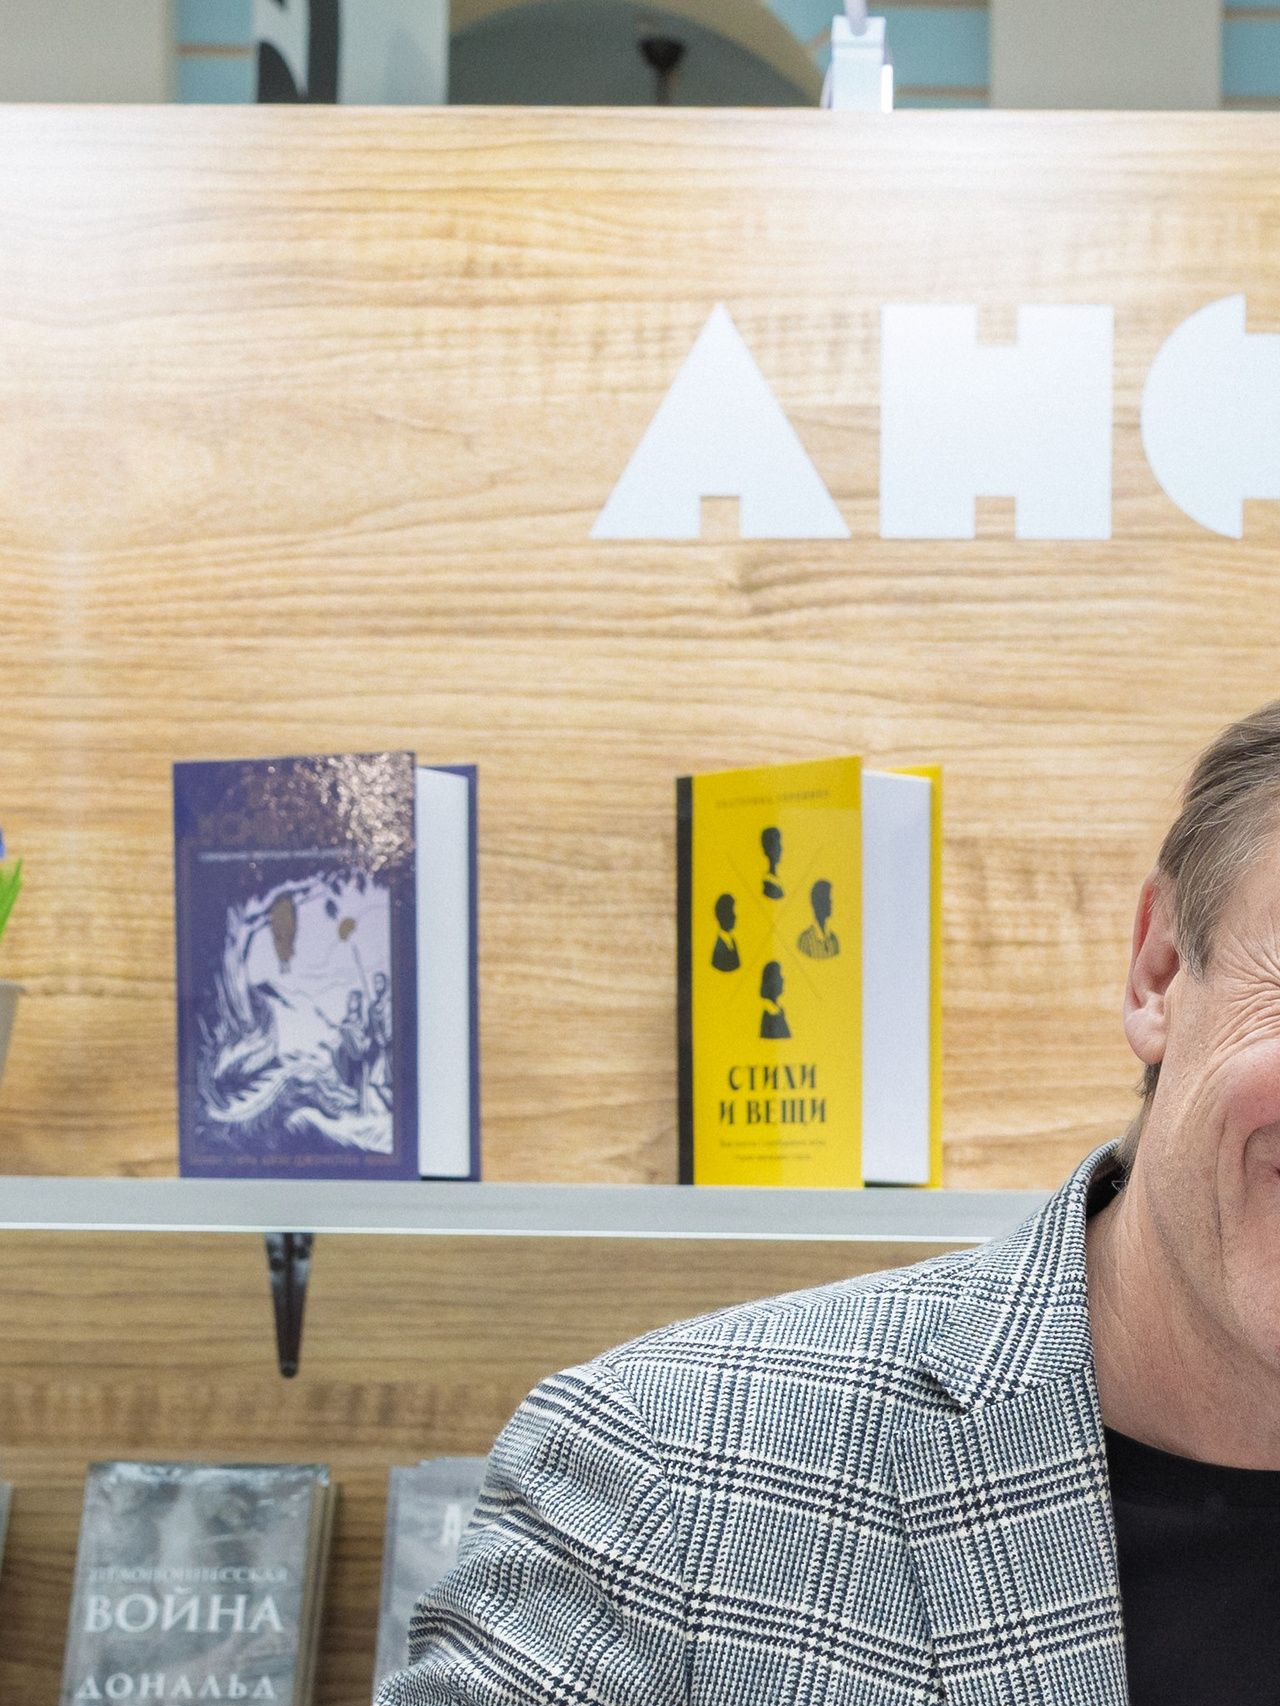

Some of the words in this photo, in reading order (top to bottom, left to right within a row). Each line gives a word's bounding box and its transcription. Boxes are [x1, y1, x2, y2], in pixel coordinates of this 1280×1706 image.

[728, 1064, 817, 1092] СТИХИ
[719, 1100, 735, 1125] И
[746, 1097, 827, 1127] ВЕЩИ
[83, 1586, 285, 1633] ВОЙНА
[74, 1672, 278, 1701] ДОНАЛЬД
